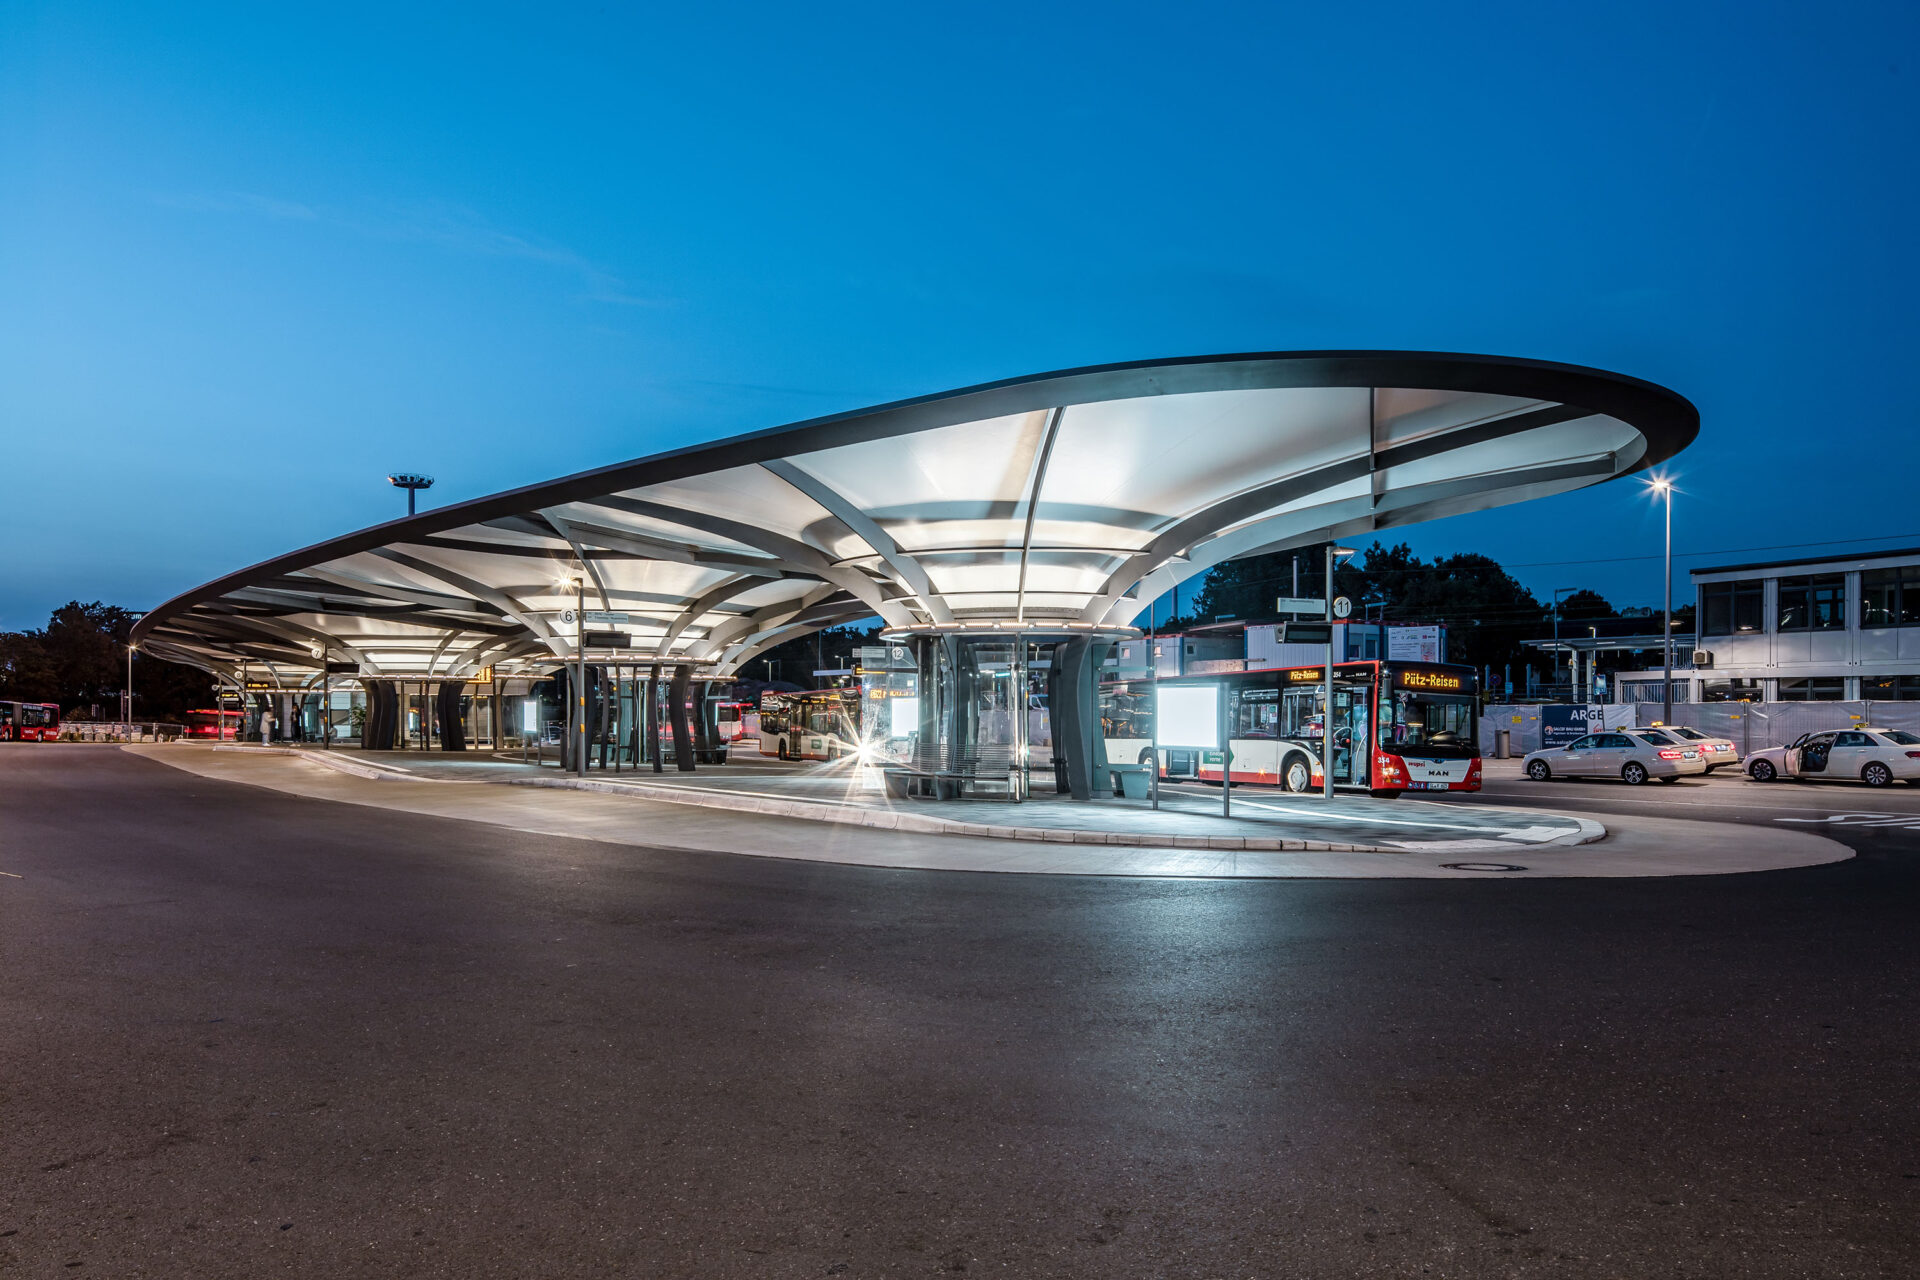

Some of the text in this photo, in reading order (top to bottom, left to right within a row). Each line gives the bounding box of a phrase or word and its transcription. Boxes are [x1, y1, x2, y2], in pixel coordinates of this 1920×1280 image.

[1338, 600, 1349, 614] 11
[565, 610, 572, 622] 6
[892, 649, 903, 658] 12
[1404, 672, 1459, 688] Pütz-Reisen
[1570, 710, 1604, 720] ARGE
